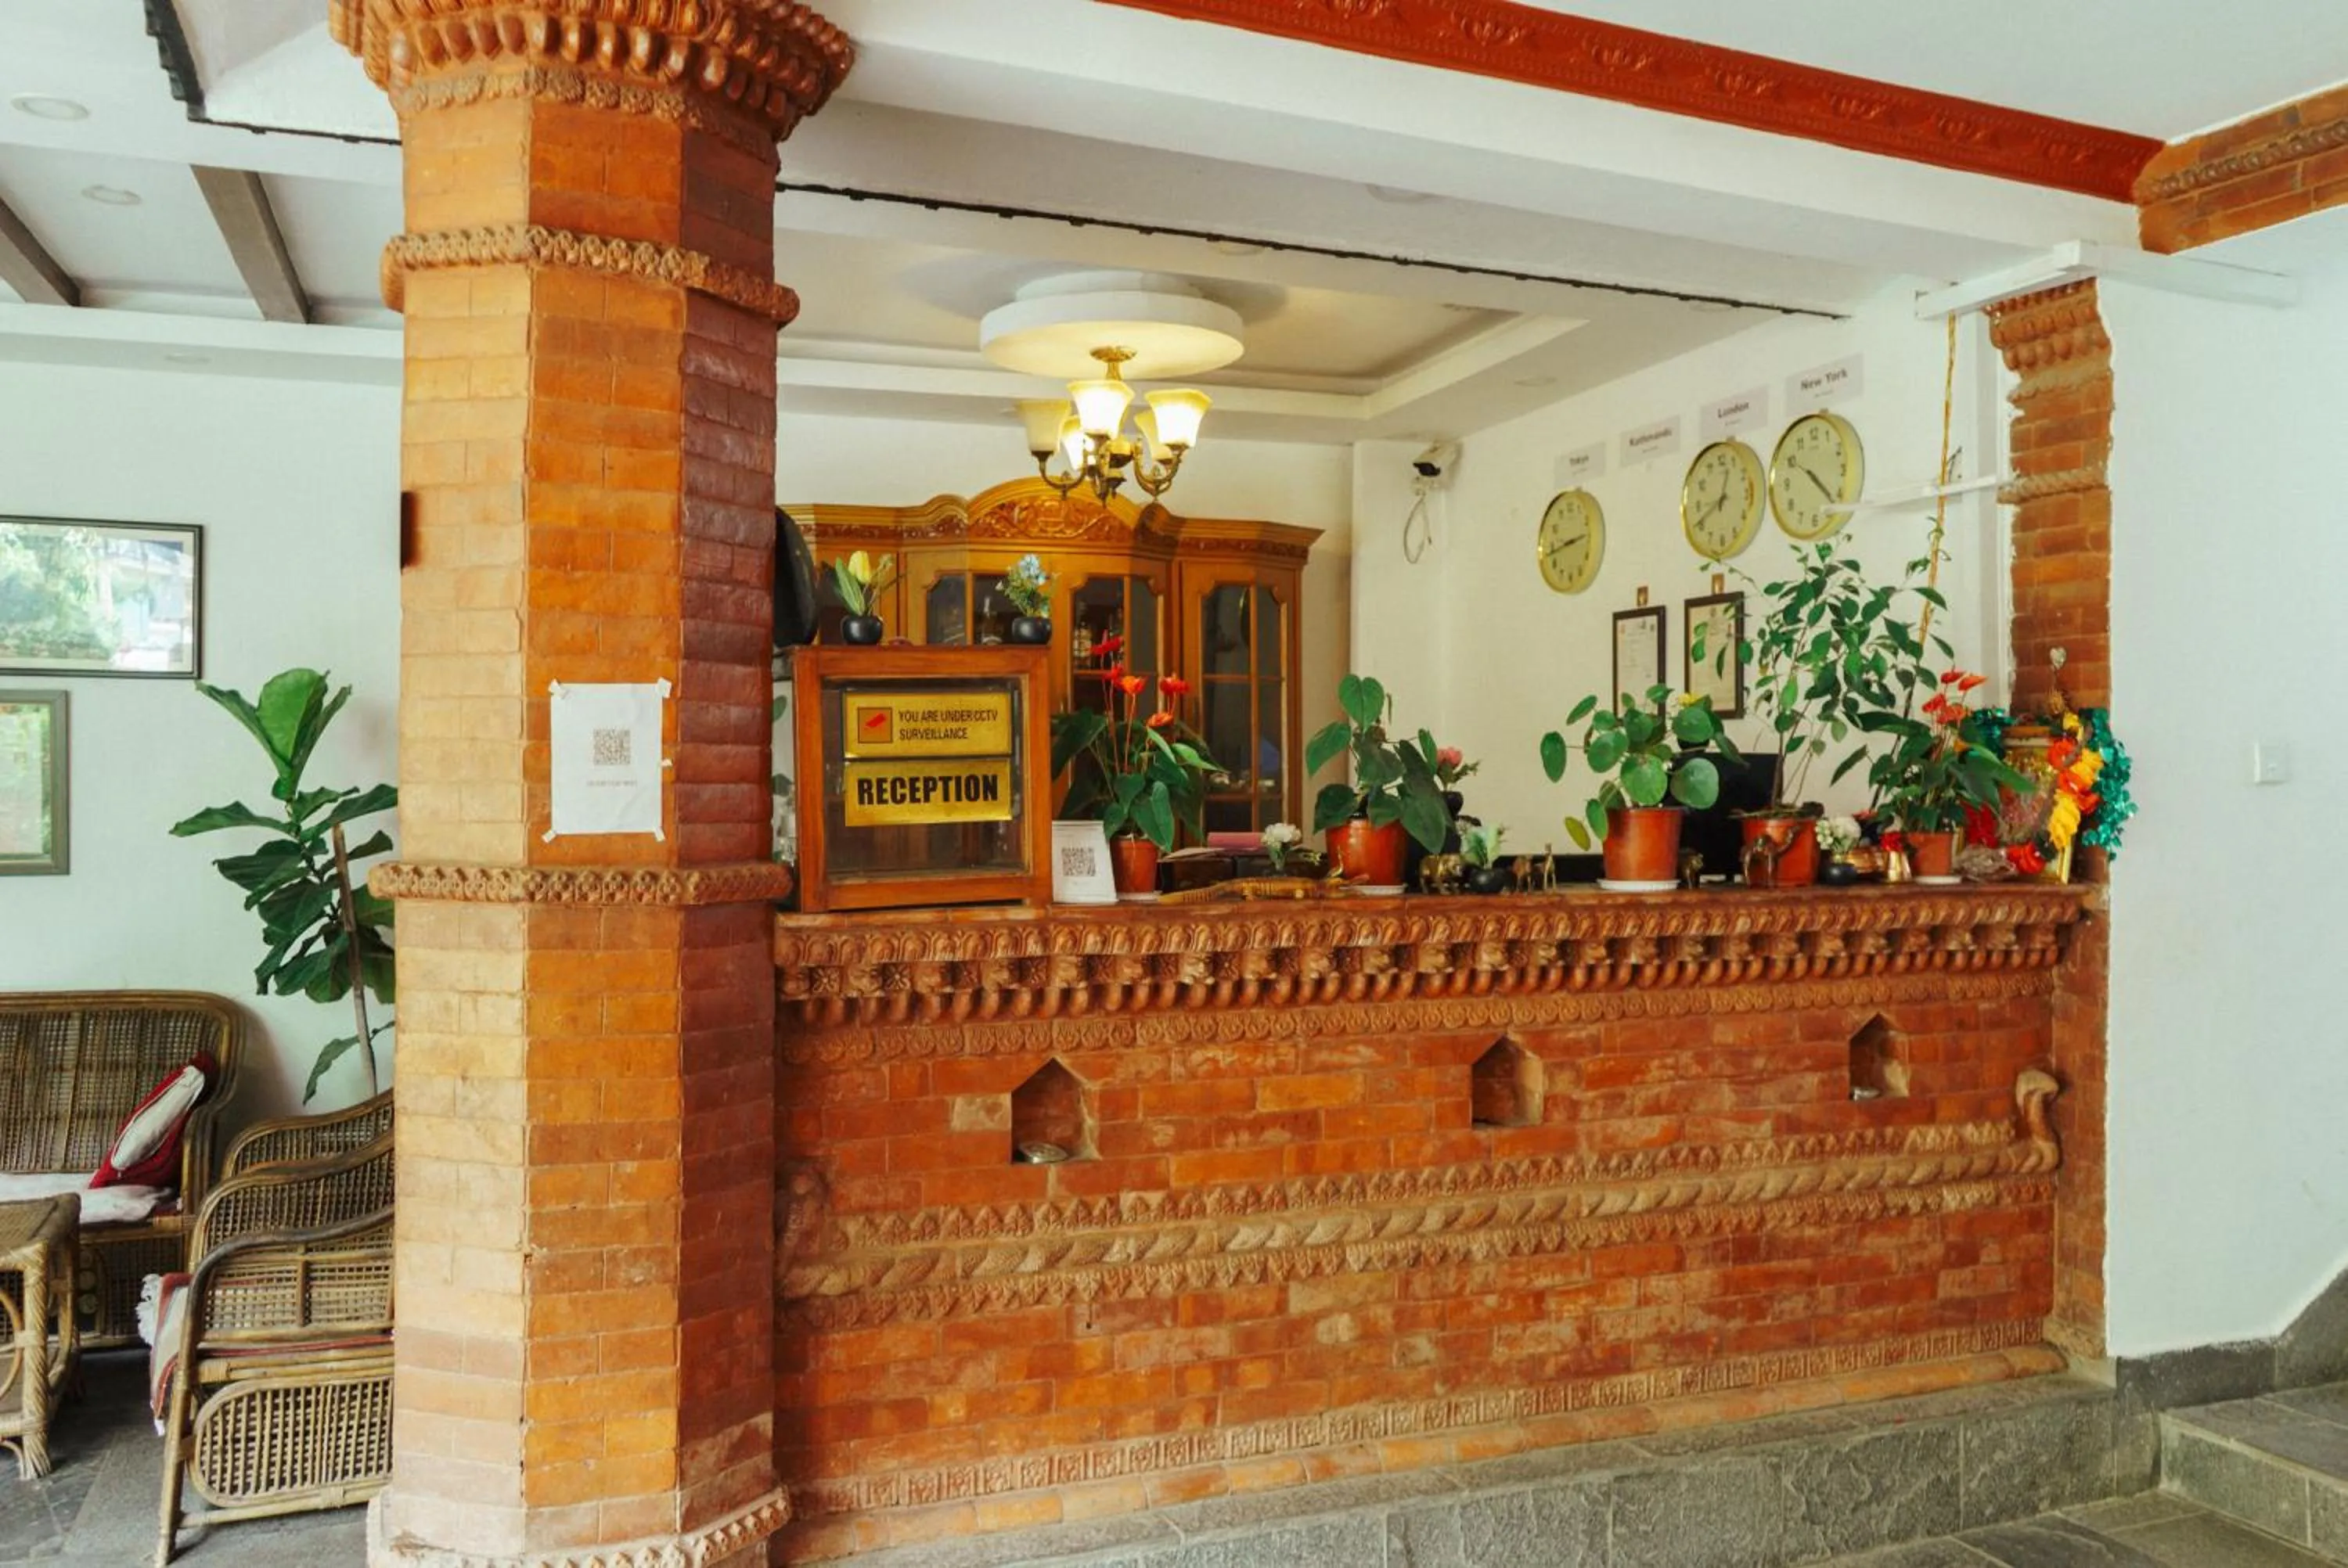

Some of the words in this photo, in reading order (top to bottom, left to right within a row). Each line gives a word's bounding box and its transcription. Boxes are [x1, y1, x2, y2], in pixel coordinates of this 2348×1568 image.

[1801, 378, 1822, 391] New
[1824, 368, 1848, 384] York
[1810, 426, 1819, 441] 12
[899, 710, 919, 723] YOU
[921, 710, 938, 721] ARE
[941, 710, 972, 722] UNDER
[974, 710, 998, 721] CCTV
[899, 727, 968, 740] SURVEILLANCE
[857, 773, 998, 806] RECEPTION
